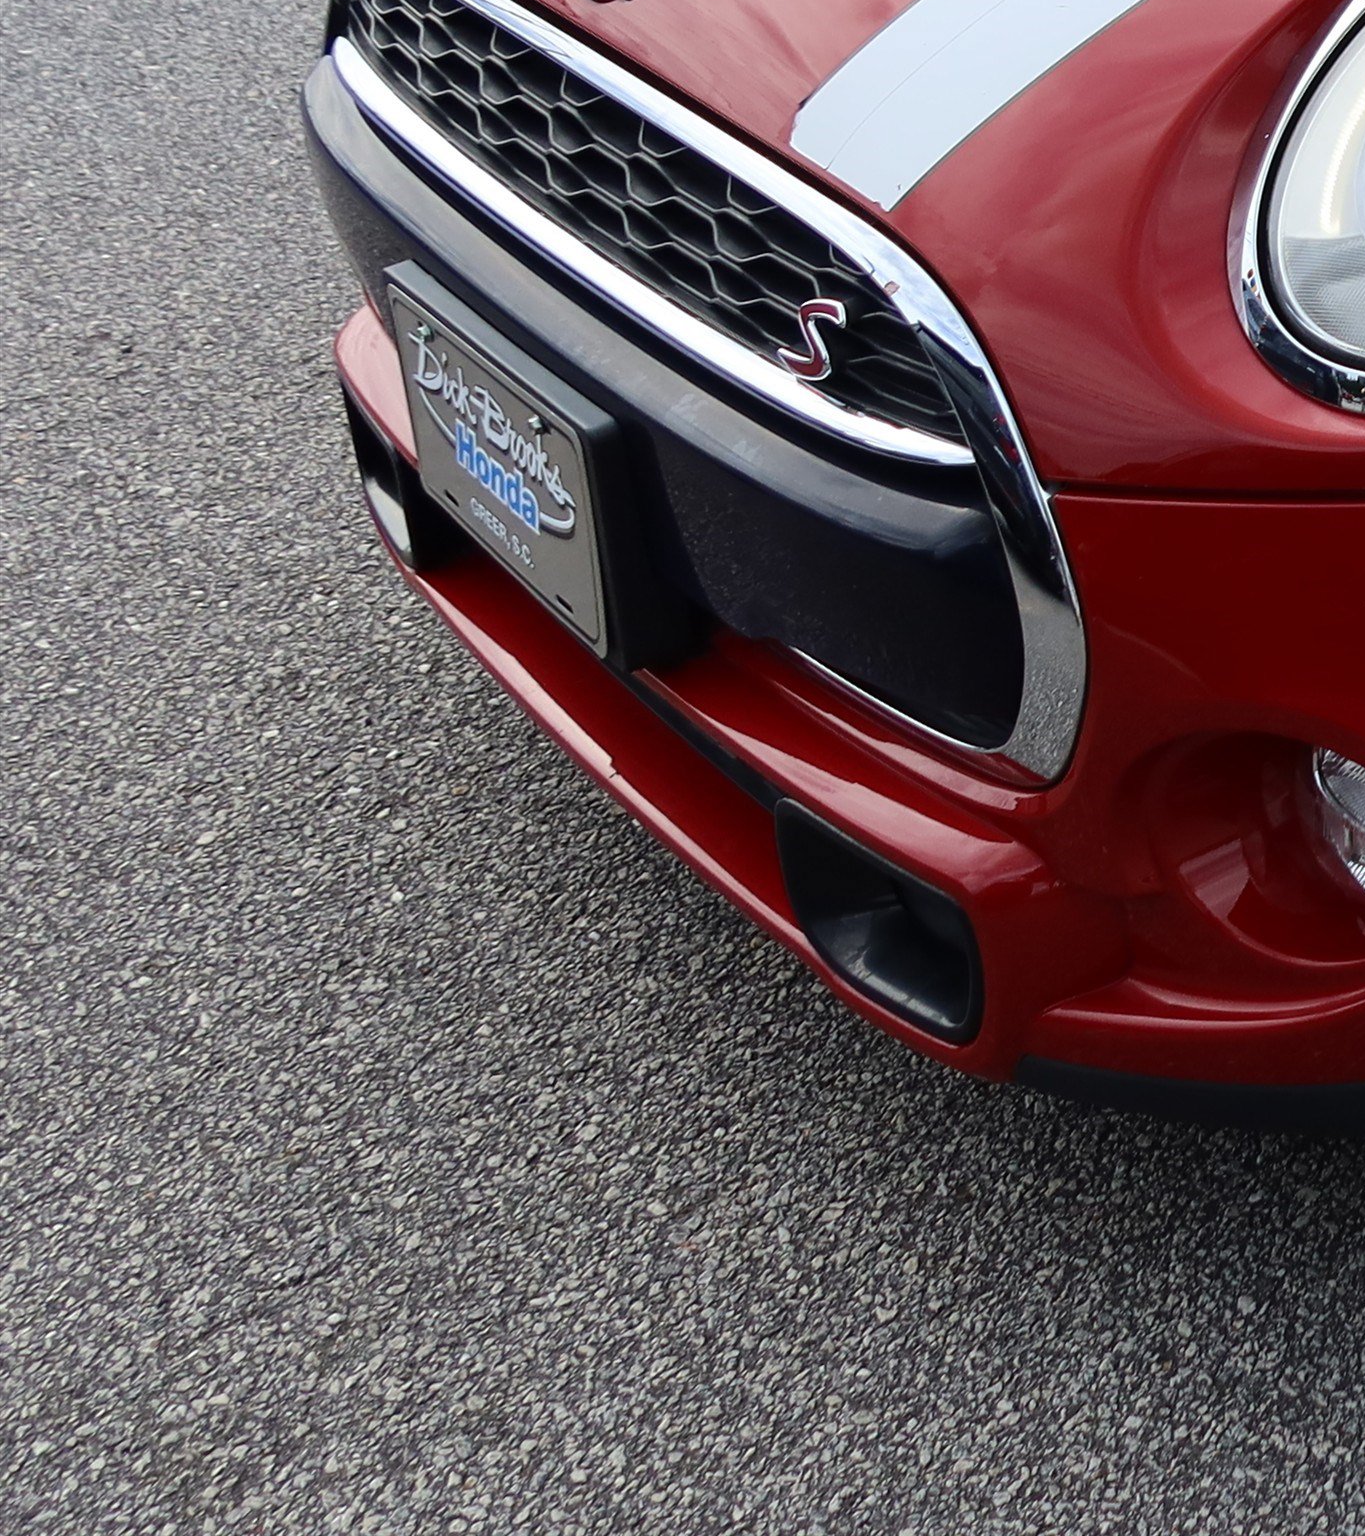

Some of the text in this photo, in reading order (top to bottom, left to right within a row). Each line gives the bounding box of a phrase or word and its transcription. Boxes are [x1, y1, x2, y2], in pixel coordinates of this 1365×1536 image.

[777, 298, 846, 381] S
[408, 332, 576, 507] Dick Brooks
[456, 418, 541, 535] Honda
[470, 498, 512, 549] GREER,
